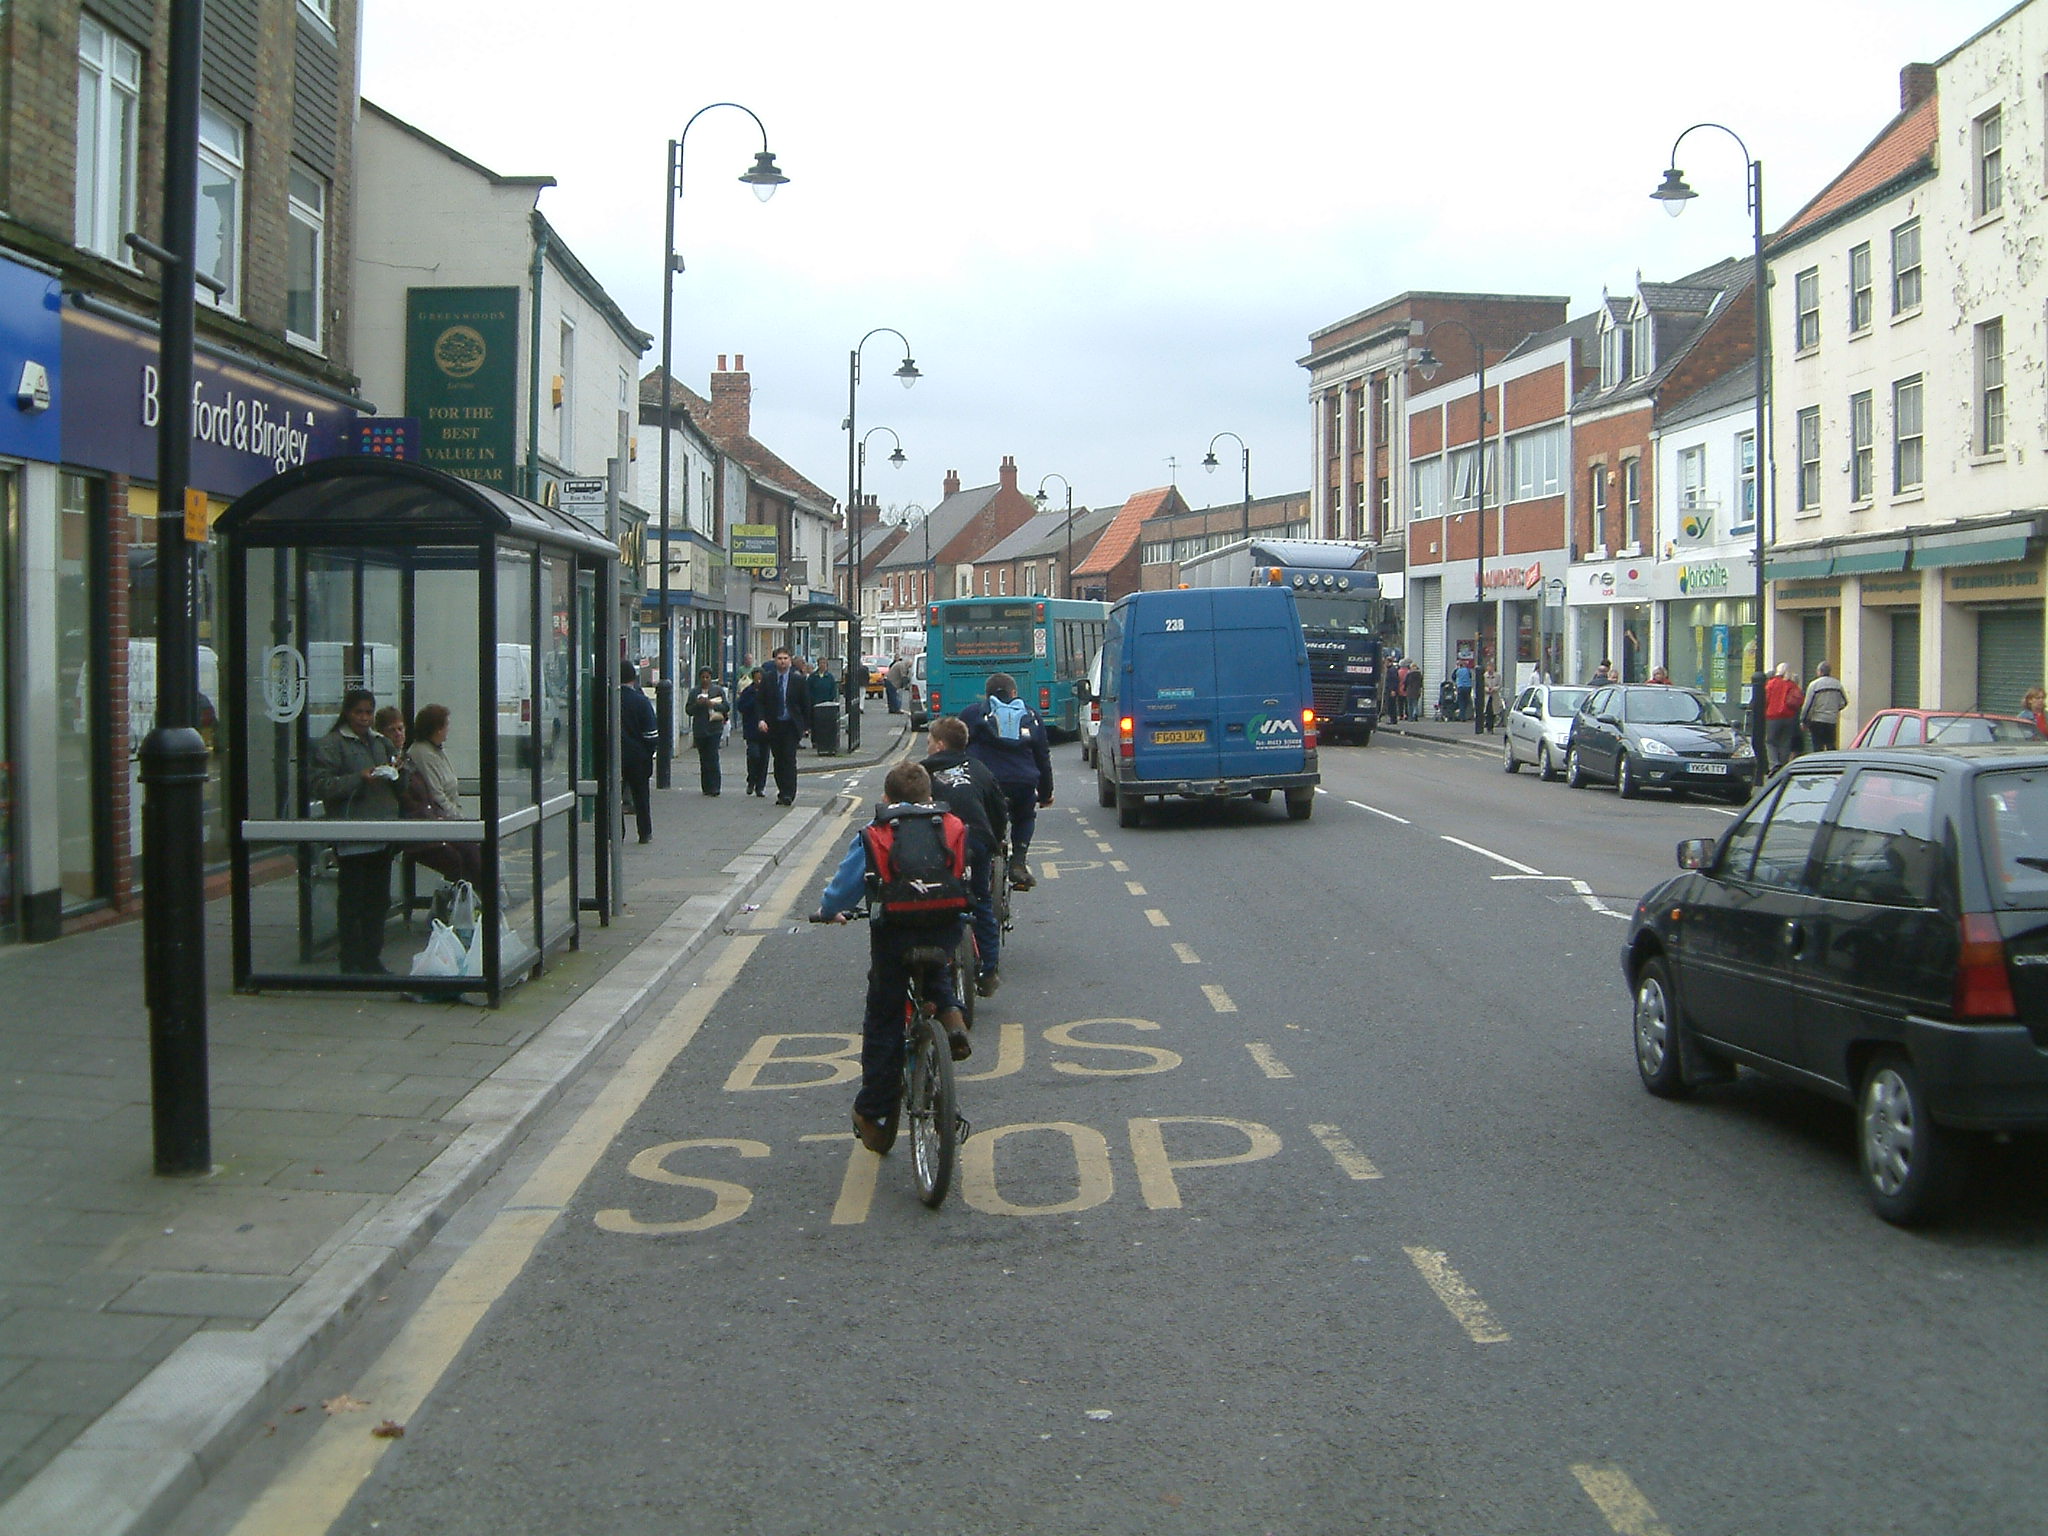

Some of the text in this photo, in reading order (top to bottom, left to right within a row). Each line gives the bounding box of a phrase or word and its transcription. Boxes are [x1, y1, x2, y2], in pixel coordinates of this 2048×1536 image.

[429, 407, 494, 419] FOR THE
[143, 365, 308, 475] Bford & Bingley
[442, 427, 480, 439] BEST
[425, 447, 495, 460] VALUE IN
[1165, 618, 1185, 631] 238
[1156, 731, 1205, 743] FG03 UKY
[1691, 763, 1727, 774] YK54 TTY
[595, 1117, 1283, 1235] STOP
